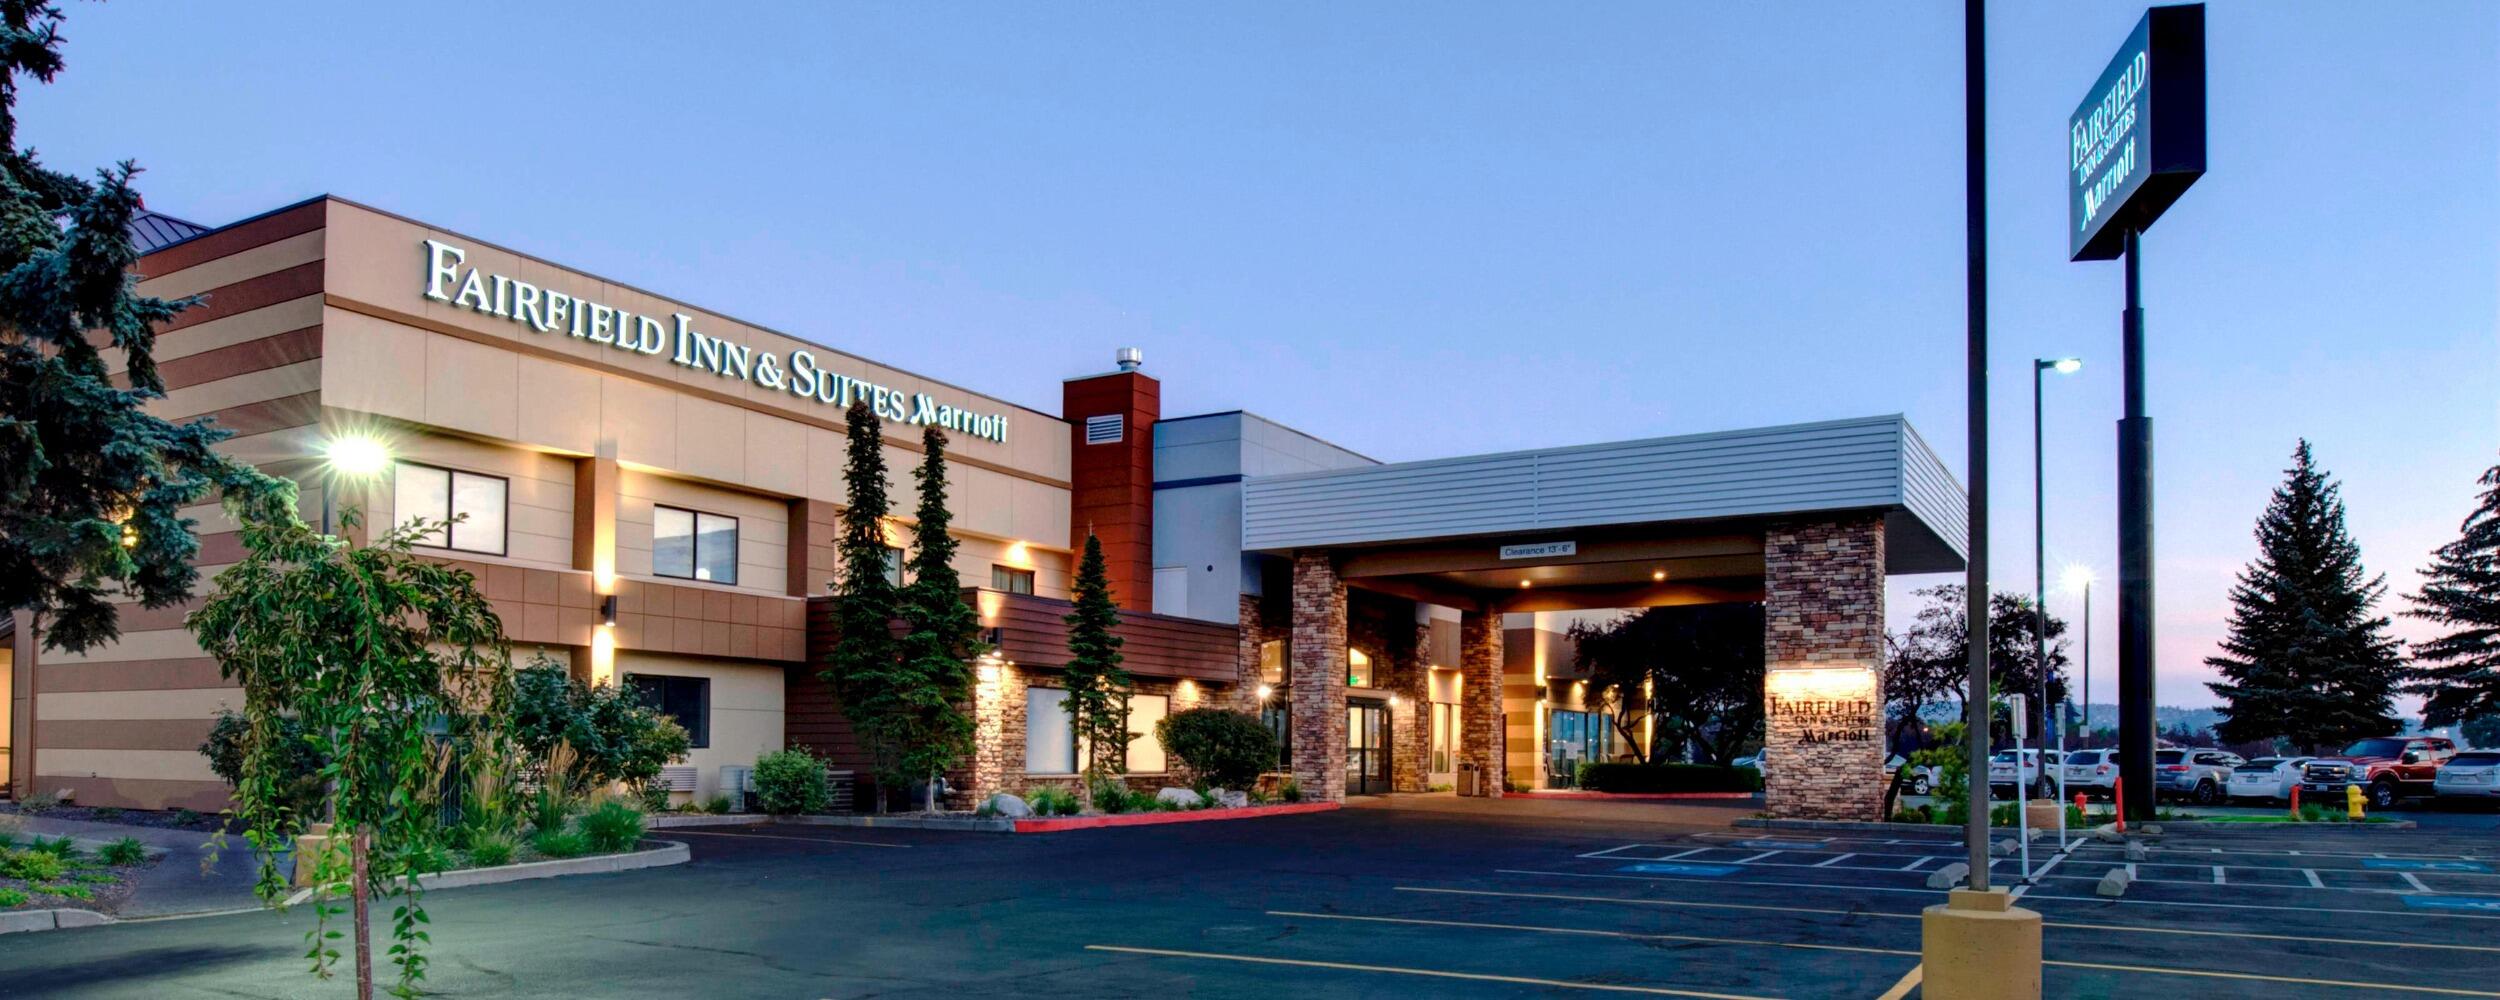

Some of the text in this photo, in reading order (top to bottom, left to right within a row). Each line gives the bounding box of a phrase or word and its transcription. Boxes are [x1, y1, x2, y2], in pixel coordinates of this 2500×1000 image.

[2072, 51, 2147, 171] FAIRFIELD
[2080, 148, 2097, 186] INN
[2104, 102, 2136, 156] SUITES
[2081, 136, 2136, 232] Marriott
[423, 239, 1008, 443] FAIRFIELD INN & SUITES Marriott
[1504, 546, 1545, 557] Clearance
[1770, 696, 1871, 716] FAIRFIELD
[1795, 715, 1817, 725] INN
[1798, 729, 1870, 744] Marriott
